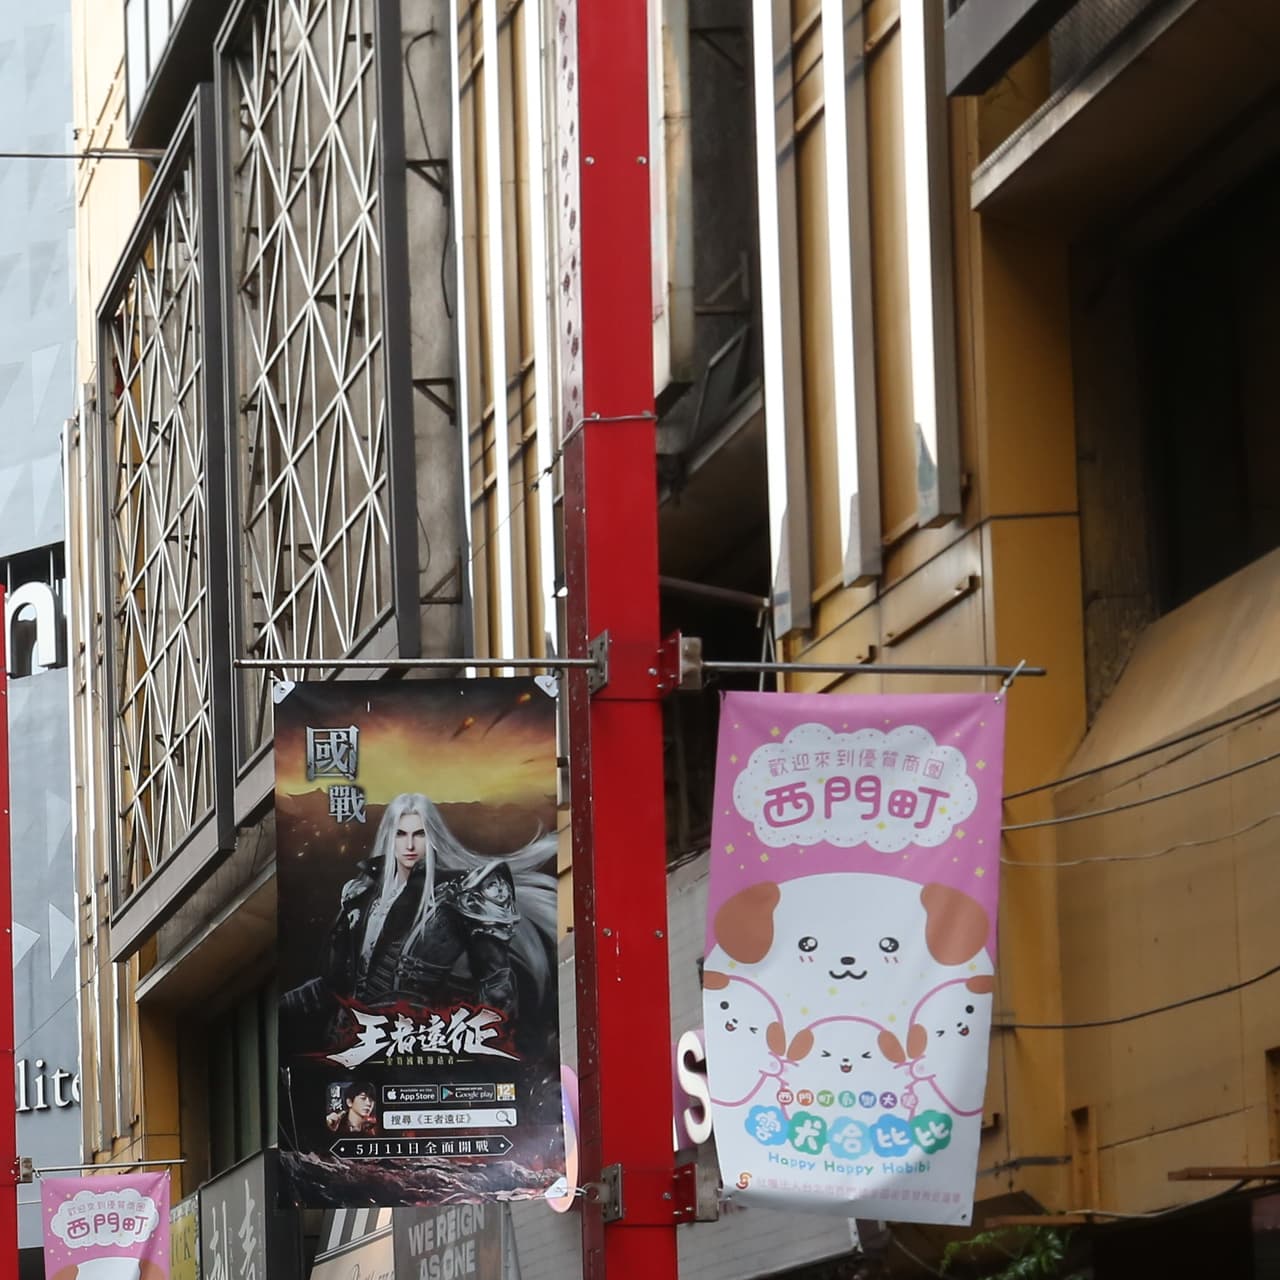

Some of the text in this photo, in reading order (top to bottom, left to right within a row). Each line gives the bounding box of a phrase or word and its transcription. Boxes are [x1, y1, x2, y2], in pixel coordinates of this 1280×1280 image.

[306, 724, 366, 823] 國戰
[767, 749, 945, 780] 歡迎來到優質商圈
[763, 775, 951, 829] 西門町
[326, 1007, 521, 1070] 王者遠征
[399, 1092, 435, 1102] App Store
[391, 1114, 473, 1126] 搜尋《王者遠征》
[355, 1140, 490, 1156] 5月11日全面開戰
[768, 1151, 930, 1176] Happy Happy Habibi
[66, 1211, 149, 1240] 西門町
[408, 1203, 485, 1257] WE REIGN
[442, 1240, 476, 1280] ONE
